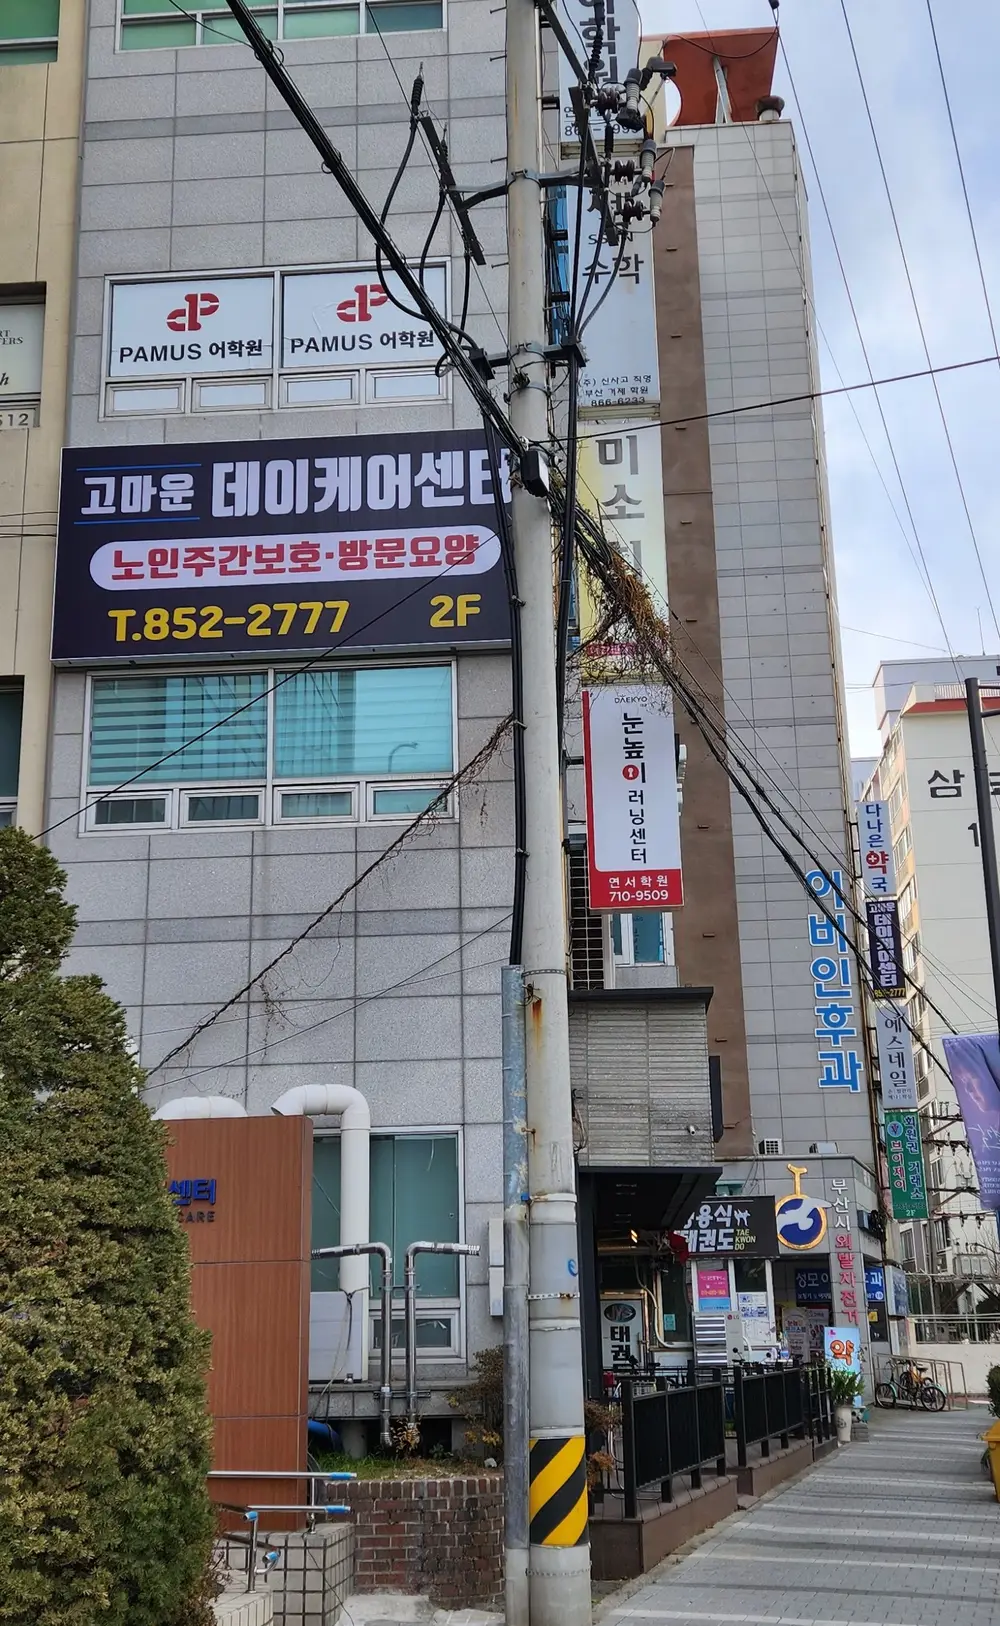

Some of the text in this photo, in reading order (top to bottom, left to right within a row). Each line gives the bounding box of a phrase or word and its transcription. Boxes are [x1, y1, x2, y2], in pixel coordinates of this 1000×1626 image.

[582, 253, 645, 285] 수학
[119, 339, 263, 363] PAMUS 어학원
[290, 330, 435, 354] PAMUS 어학원
[601, 376, 629, 386] 신사고
[634, 374, 652, 384] 직영
[630, 386, 648, 395] 학원
[591, 397, 645, 406] 866-6233
[81, 448, 513, 518] 고마운 데이케어센터
[108, 593, 482, 642] T.852-2777 2F
[614, 695, 647, 704] DAEKYO
[621, 712, 647, 864] 눈높이 러닝센터
[609, 889, 669, 902] 710-9509
[805, 869, 864, 1093] 이비인후과
[884, 1016, 908, 1088] 에스네일
[890, 1140, 907, 1192] 브이제이
[831, 1179, 851, 1231] 부산시
[905, 1209, 916, 1217] 2F
